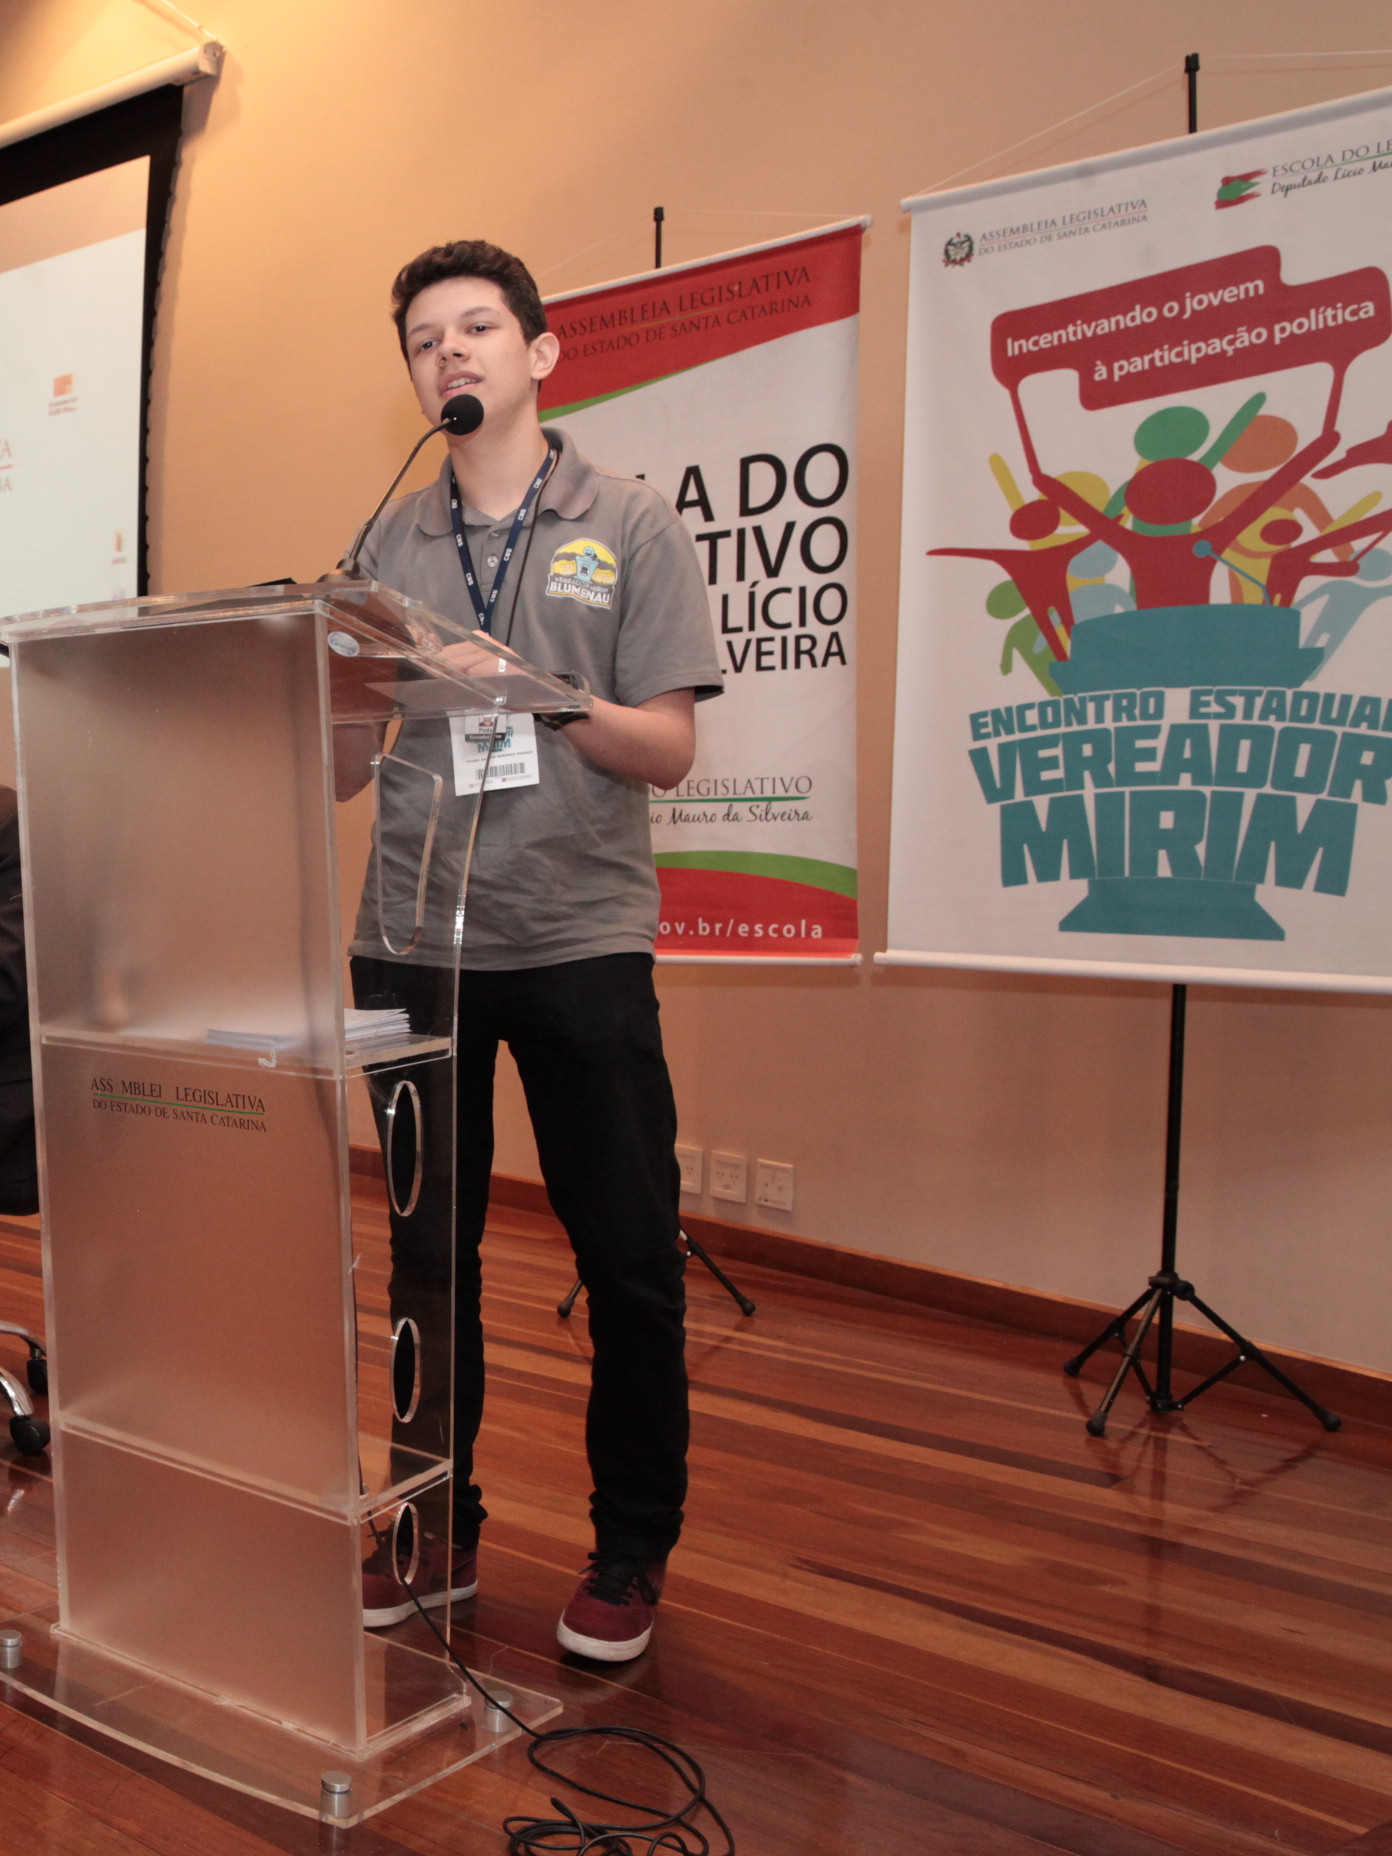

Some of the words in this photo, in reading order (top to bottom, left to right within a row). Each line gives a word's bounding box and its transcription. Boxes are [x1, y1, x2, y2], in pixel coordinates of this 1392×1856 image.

[1272, 153, 1334, 178] ESCOLA
[1341, 145, 1370, 162] DO
[1271, 170, 1329, 198] Deputado
[978, 246, 995, 257] DO
[997, 237, 1037, 253] ESTADO
[1039, 233, 1053, 244] DE
[1056, 226, 1090, 241] SANTA
[1092, 214, 1148, 233] CATARINA
[979, 218, 1058, 243] ASSEMBLEIA
[1062, 199, 1148, 226] LEGISLATIVA
[558, 300, 671, 339] ASSEMBLEIA
[679, 266, 810, 312] LEGISLATIVA
[1007, 306, 1159, 357] Incentivando
[1162, 302, 1180, 319] o
[1182, 279, 1265, 319] jovem
[583, 331, 640, 357] ESTADO
[645, 327, 665, 343] DE
[670, 315, 721, 338] SANTA
[726, 295, 812, 326] CATARINA
[1093, 361, 1108, 382] à
[1112, 325, 1268, 382] participação
[1273, 301, 1376, 345] política
[739, 443, 849, 518] DO
[549, 581, 610, 604] BLUMENAU
[721, 580, 848, 635] LÍCIO
[721, 631, 847, 675] VEIRA
[969, 689, 1166, 742] ENCONTRO
[676, 775, 813, 798] LEGISLATIVO
[666, 807, 717, 826] Mauro
[722, 803, 742, 823] da
[746, 801, 813, 823] Silveira
[999, 789, 1359, 897] MIRIM
[658, 917, 823, 939] ov.br/escola
[92, 1099, 108, 1111] DO
[110, 1101, 151, 1117] ESTADO
[154, 1107, 170, 1119] DE
[172, 1108, 207, 1125] SANTA
[210, 1114, 267, 1133] CATARINA
[175, 1086, 266, 1113] LEGISLATIVA
